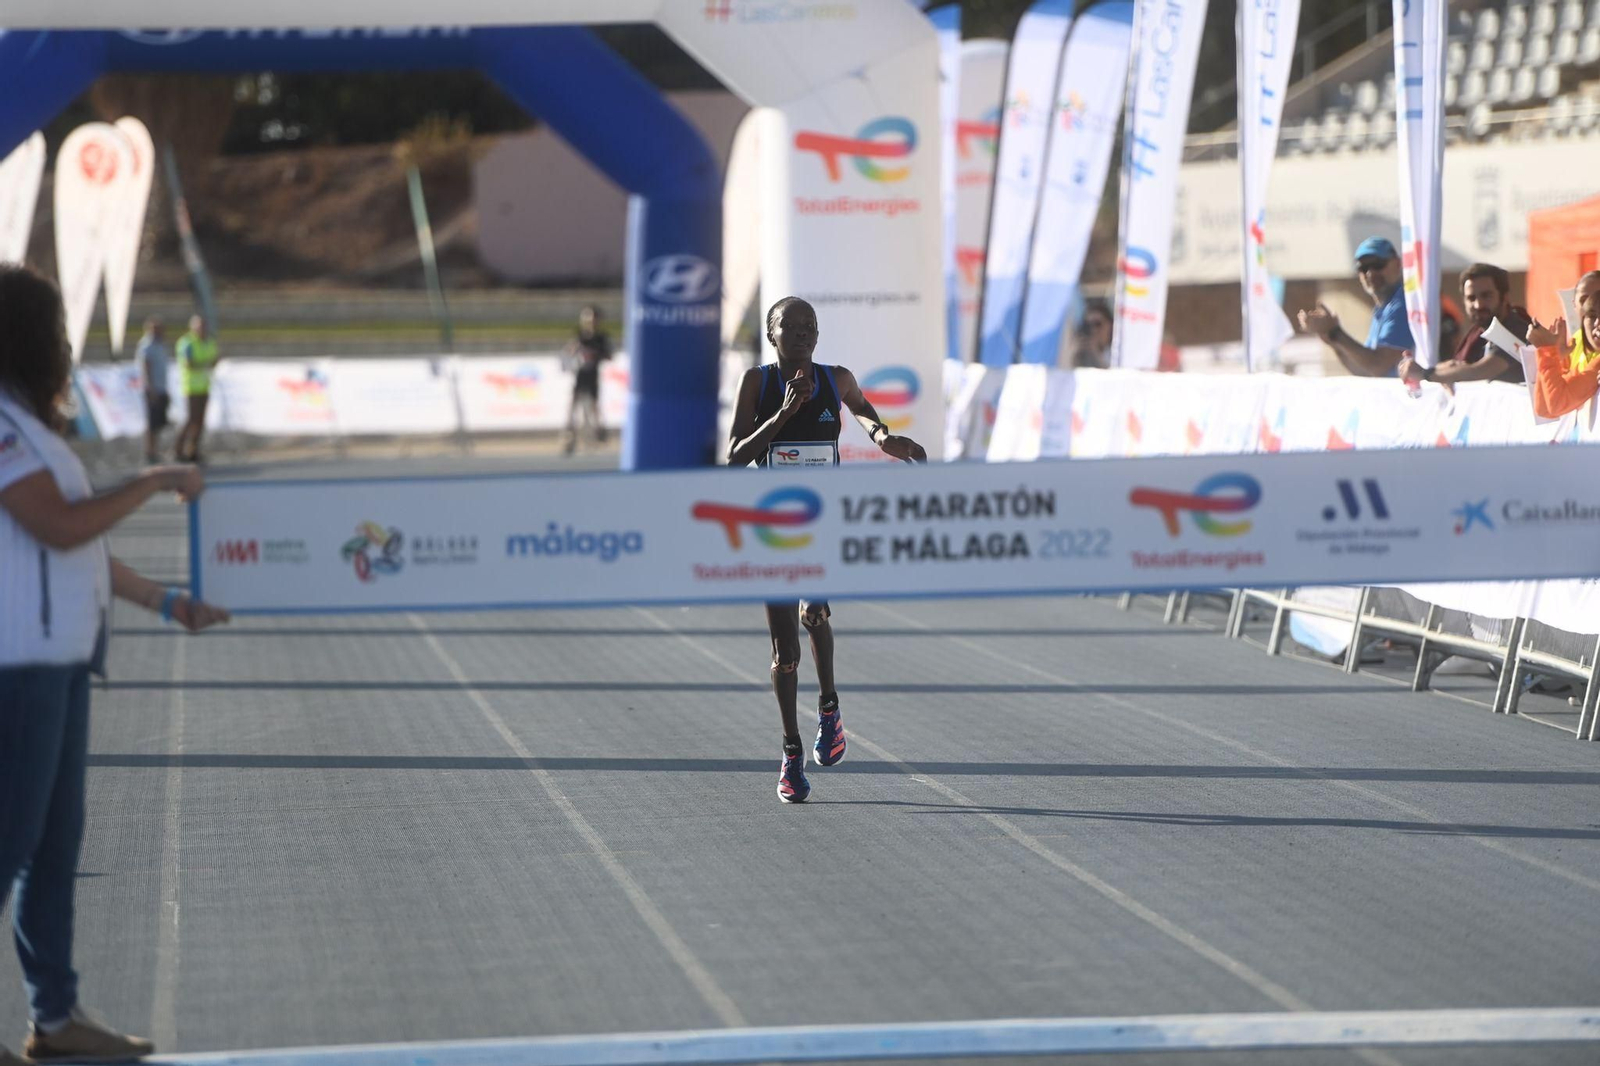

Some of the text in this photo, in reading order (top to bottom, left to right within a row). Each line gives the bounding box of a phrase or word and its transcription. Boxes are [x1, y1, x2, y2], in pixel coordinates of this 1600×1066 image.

[795, 198, 920, 219] TotalEnergies
[841, 485, 1056, 522] 1/2 MARATÓN
[842, 527, 1112, 564] DE MÁLAGA 2022
[693, 563, 825, 583] TotalEnergies
[1131, 550, 1266, 573] TotalEnergies
